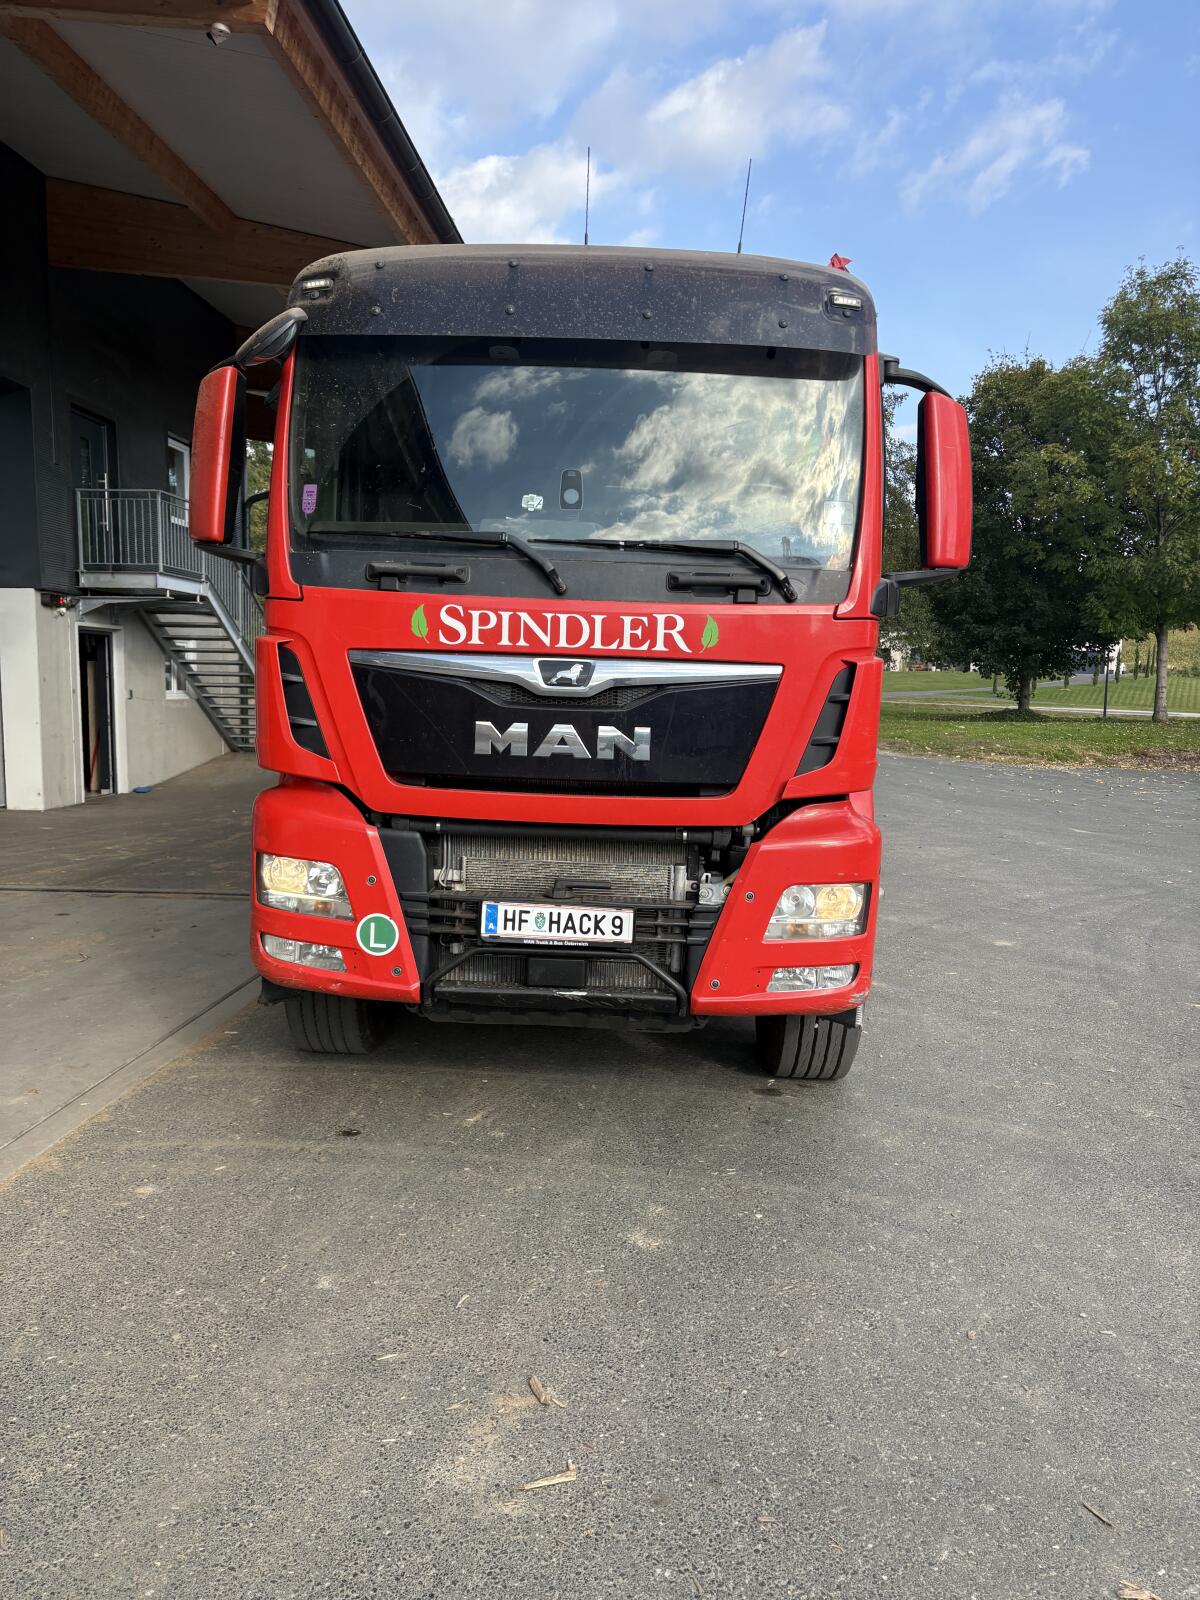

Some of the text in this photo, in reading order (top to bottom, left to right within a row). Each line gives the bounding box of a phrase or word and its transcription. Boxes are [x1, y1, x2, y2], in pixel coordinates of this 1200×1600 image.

[438, 603, 693, 653] SPINDLER
[474, 720, 651, 761] MAN
[369, 922, 387, 949] L
[503, 909, 624, 936] HF HACK 9
